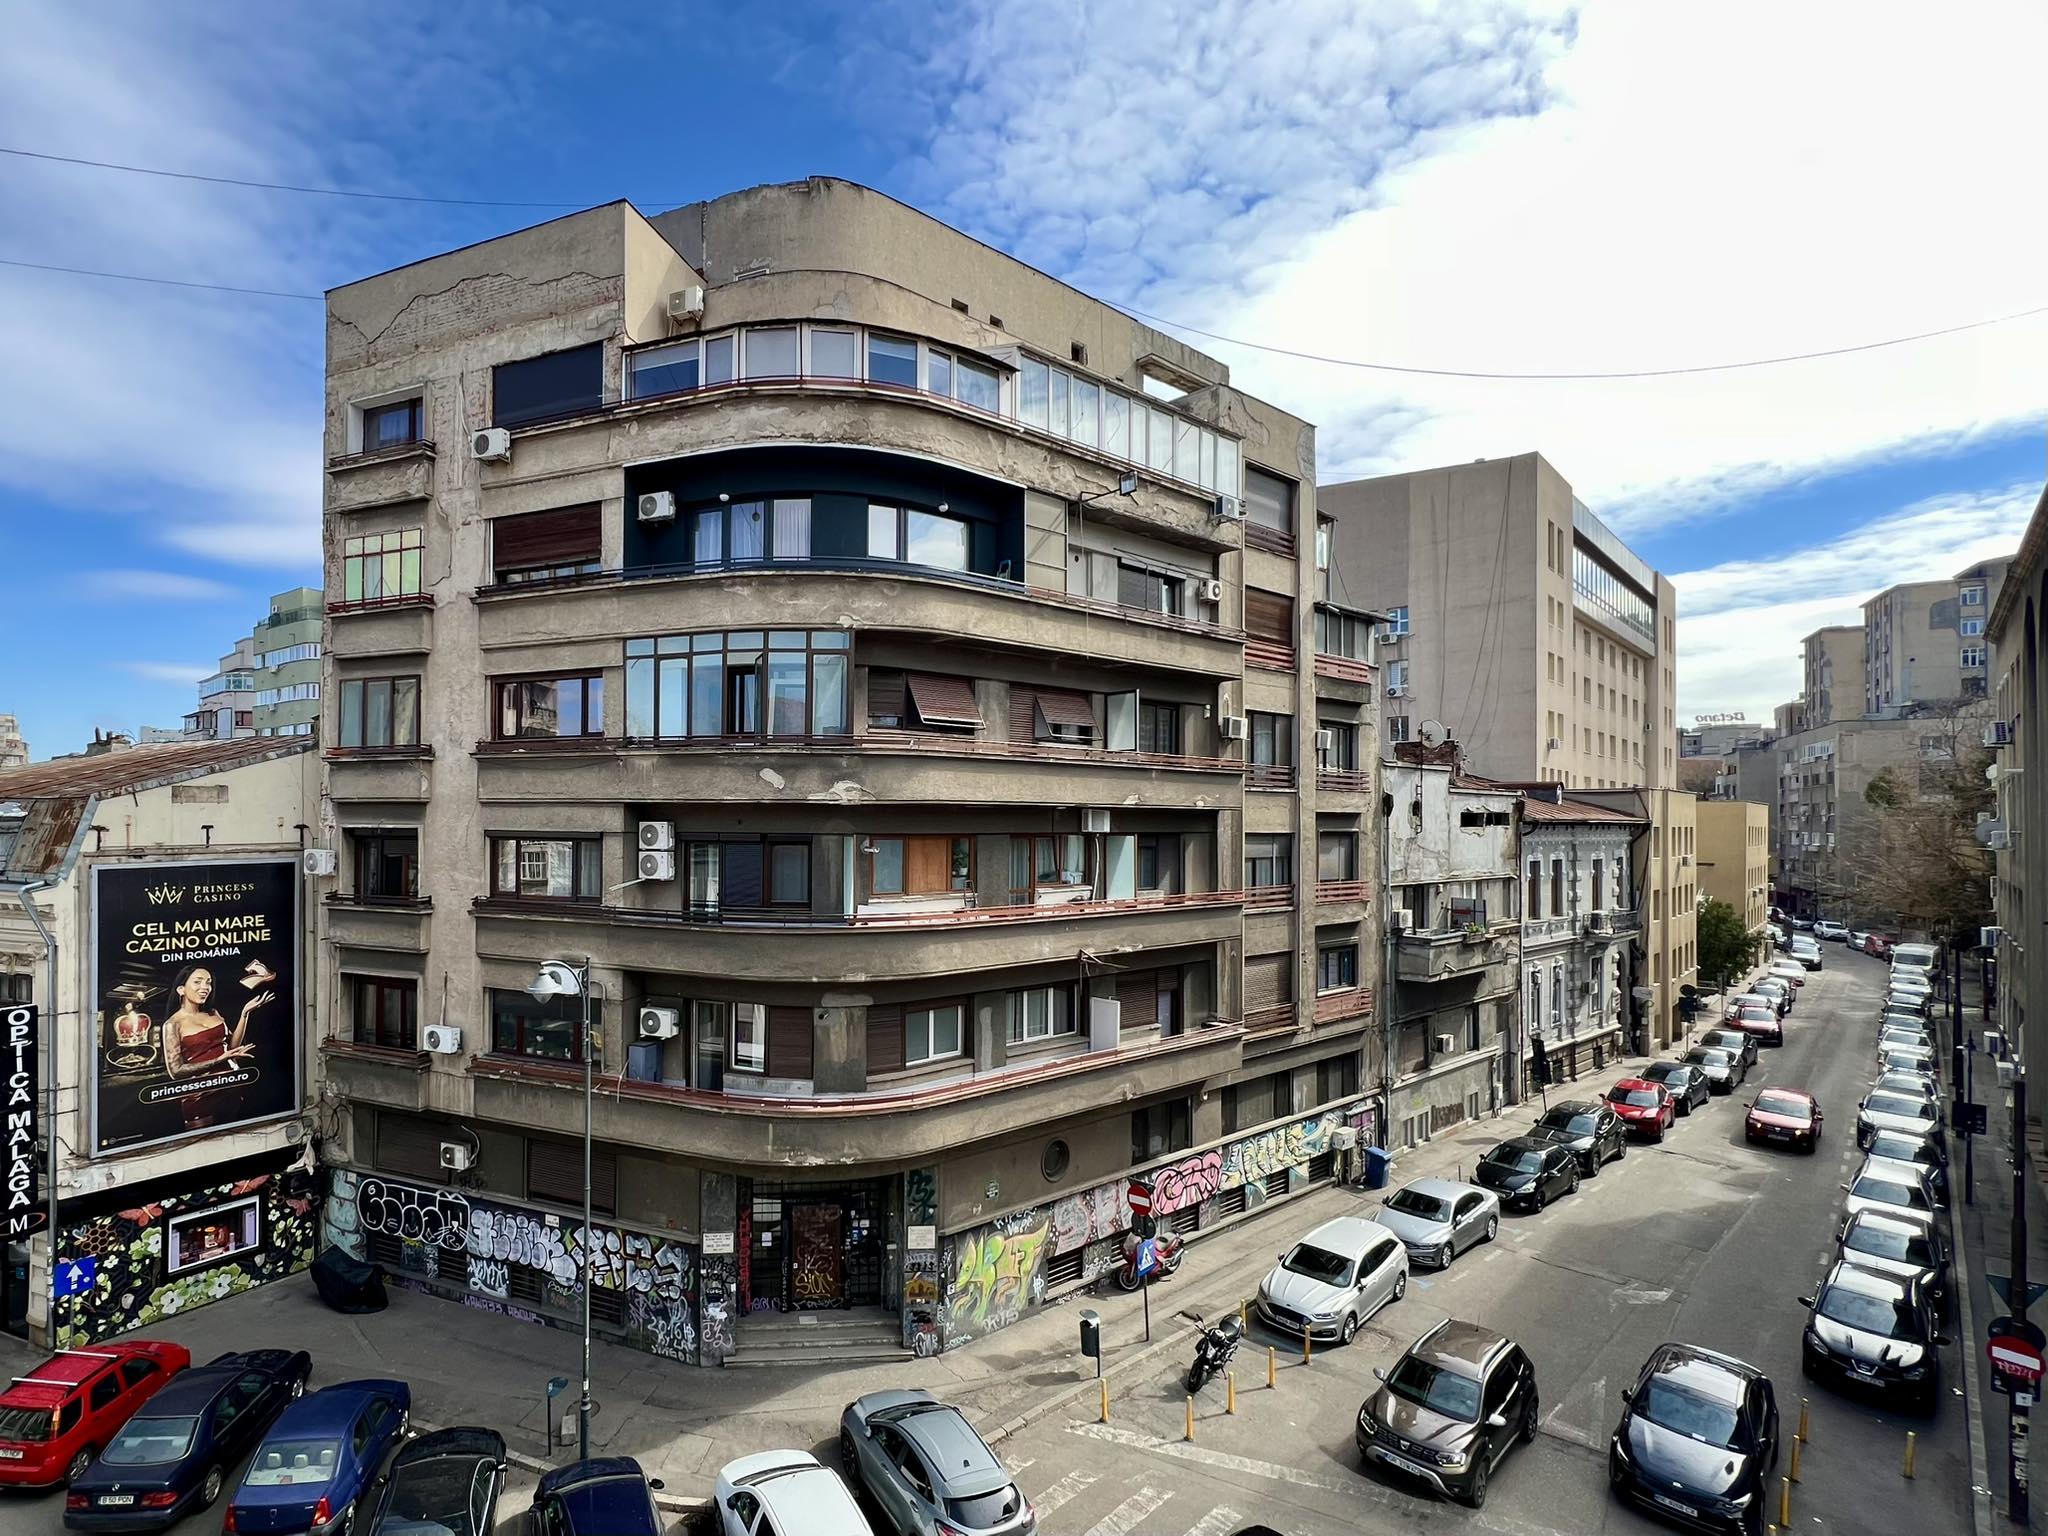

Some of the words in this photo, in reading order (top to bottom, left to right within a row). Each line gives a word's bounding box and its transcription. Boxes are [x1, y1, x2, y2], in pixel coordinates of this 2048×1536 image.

[193, 893, 242, 904] CASINO
[194, 883, 255, 894] PRINCESS
[132, 922, 170, 937] CEL
[174, 918, 209, 934] MAI
[214, 914, 266, 931] MARE
[125, 935, 200, 954] CAZINO
[204, 929, 272, 947] ONLINE
[161, 952, 183, 963] DIN
[186, 946, 241, 960] ROMÂNIA
[8, 1009, 32, 1106] OPTICA
[150, 1072, 249, 1100] princesscasino.ro
[8, 1110, 32, 1210] MALAGA
[10, 1214, 28, 1234] M
